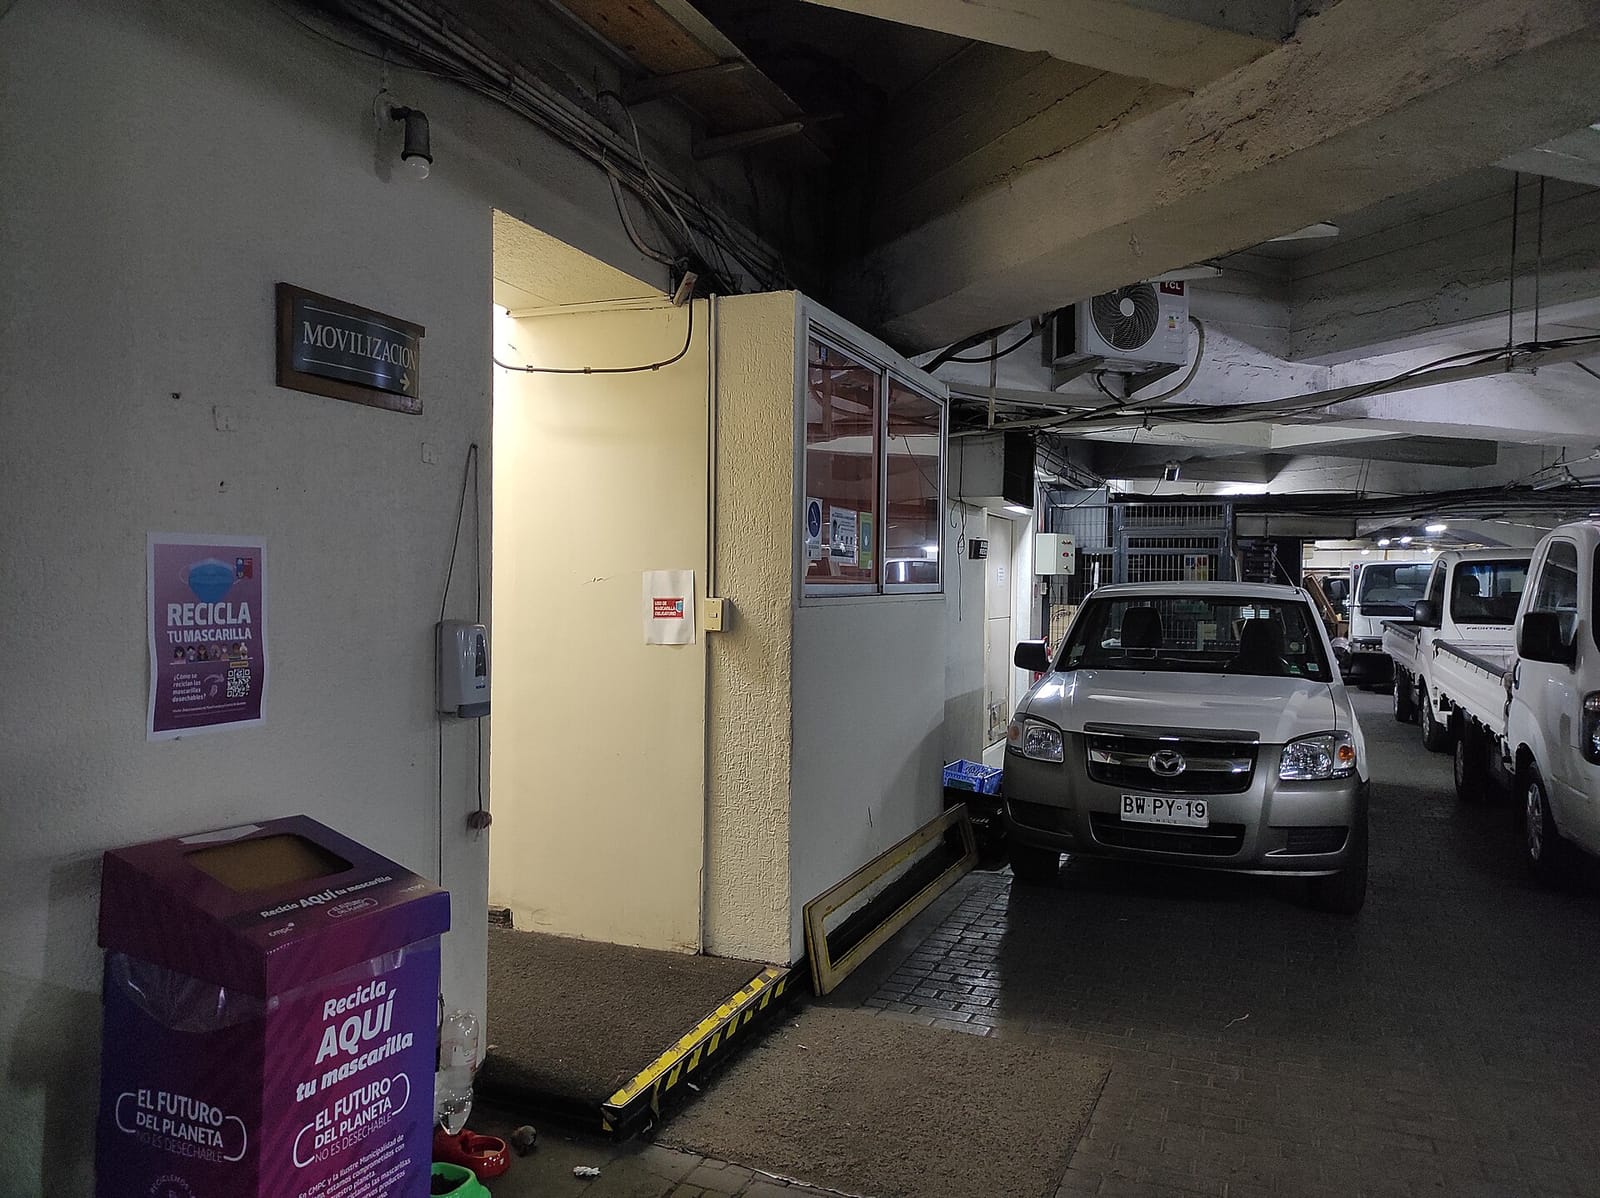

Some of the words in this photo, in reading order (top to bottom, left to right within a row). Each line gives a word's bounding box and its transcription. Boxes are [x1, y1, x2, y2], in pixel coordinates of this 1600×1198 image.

[1164, 281, 1181, 290] TCL
[302, 320, 416, 371] MOVILIZACION
[167, 602, 252, 626] RECICLA
[167, 630, 182, 643] TU
[183, 627, 252, 643] MASCARILLA
[260, 903, 299, 918] Recicla
[299, 889, 337, 908] AQUÍ
[335, 888, 348, 897] tu
[346, 875, 393, 893] mascarilla
[322, 979, 387, 1021] Recicla
[315, 988, 397, 1065] AQUÍ
[296, 1077, 317, 1102] tu
[320, 1031, 414, 1091] mascarilla
[137, 1089, 154, 1110] EL
[157, 1091, 223, 1127] FUTURO
[314, 1127, 338, 1150] DEL
[339, 1096, 392, 1137] PLANETA
[315, 1108, 332, 1131] EL
[334, 1077, 391, 1122] FUTURO
[136, 1111, 160, 1132] DEL
[162, 1118, 224, 1148] PLANETA
[164, 1137, 223, 1163] DESECHABLE
[314, 1148, 329, 1163] NO
[330, 1140, 341, 1156] ES
[342, 1111, 393, 1150] DESECHABLE
[308, 1179, 326, 1196] CMPC
[326, 1177, 332, 1186] y
[332, 1173, 339, 1182] la
[339, 1161, 359, 1177] Ilustre
[359, 1137, 397, 1165] Municipalidad
[397, 1134, 404, 1143] de
[326, 1175, 352, 1195] estamos
[352, 1149, 394, 1179] comprometidos
[394, 1143, 405, 1153] con
[378, 1170, 406, 1193] productos
[380, 1158, 412, 1181] mascarillas
